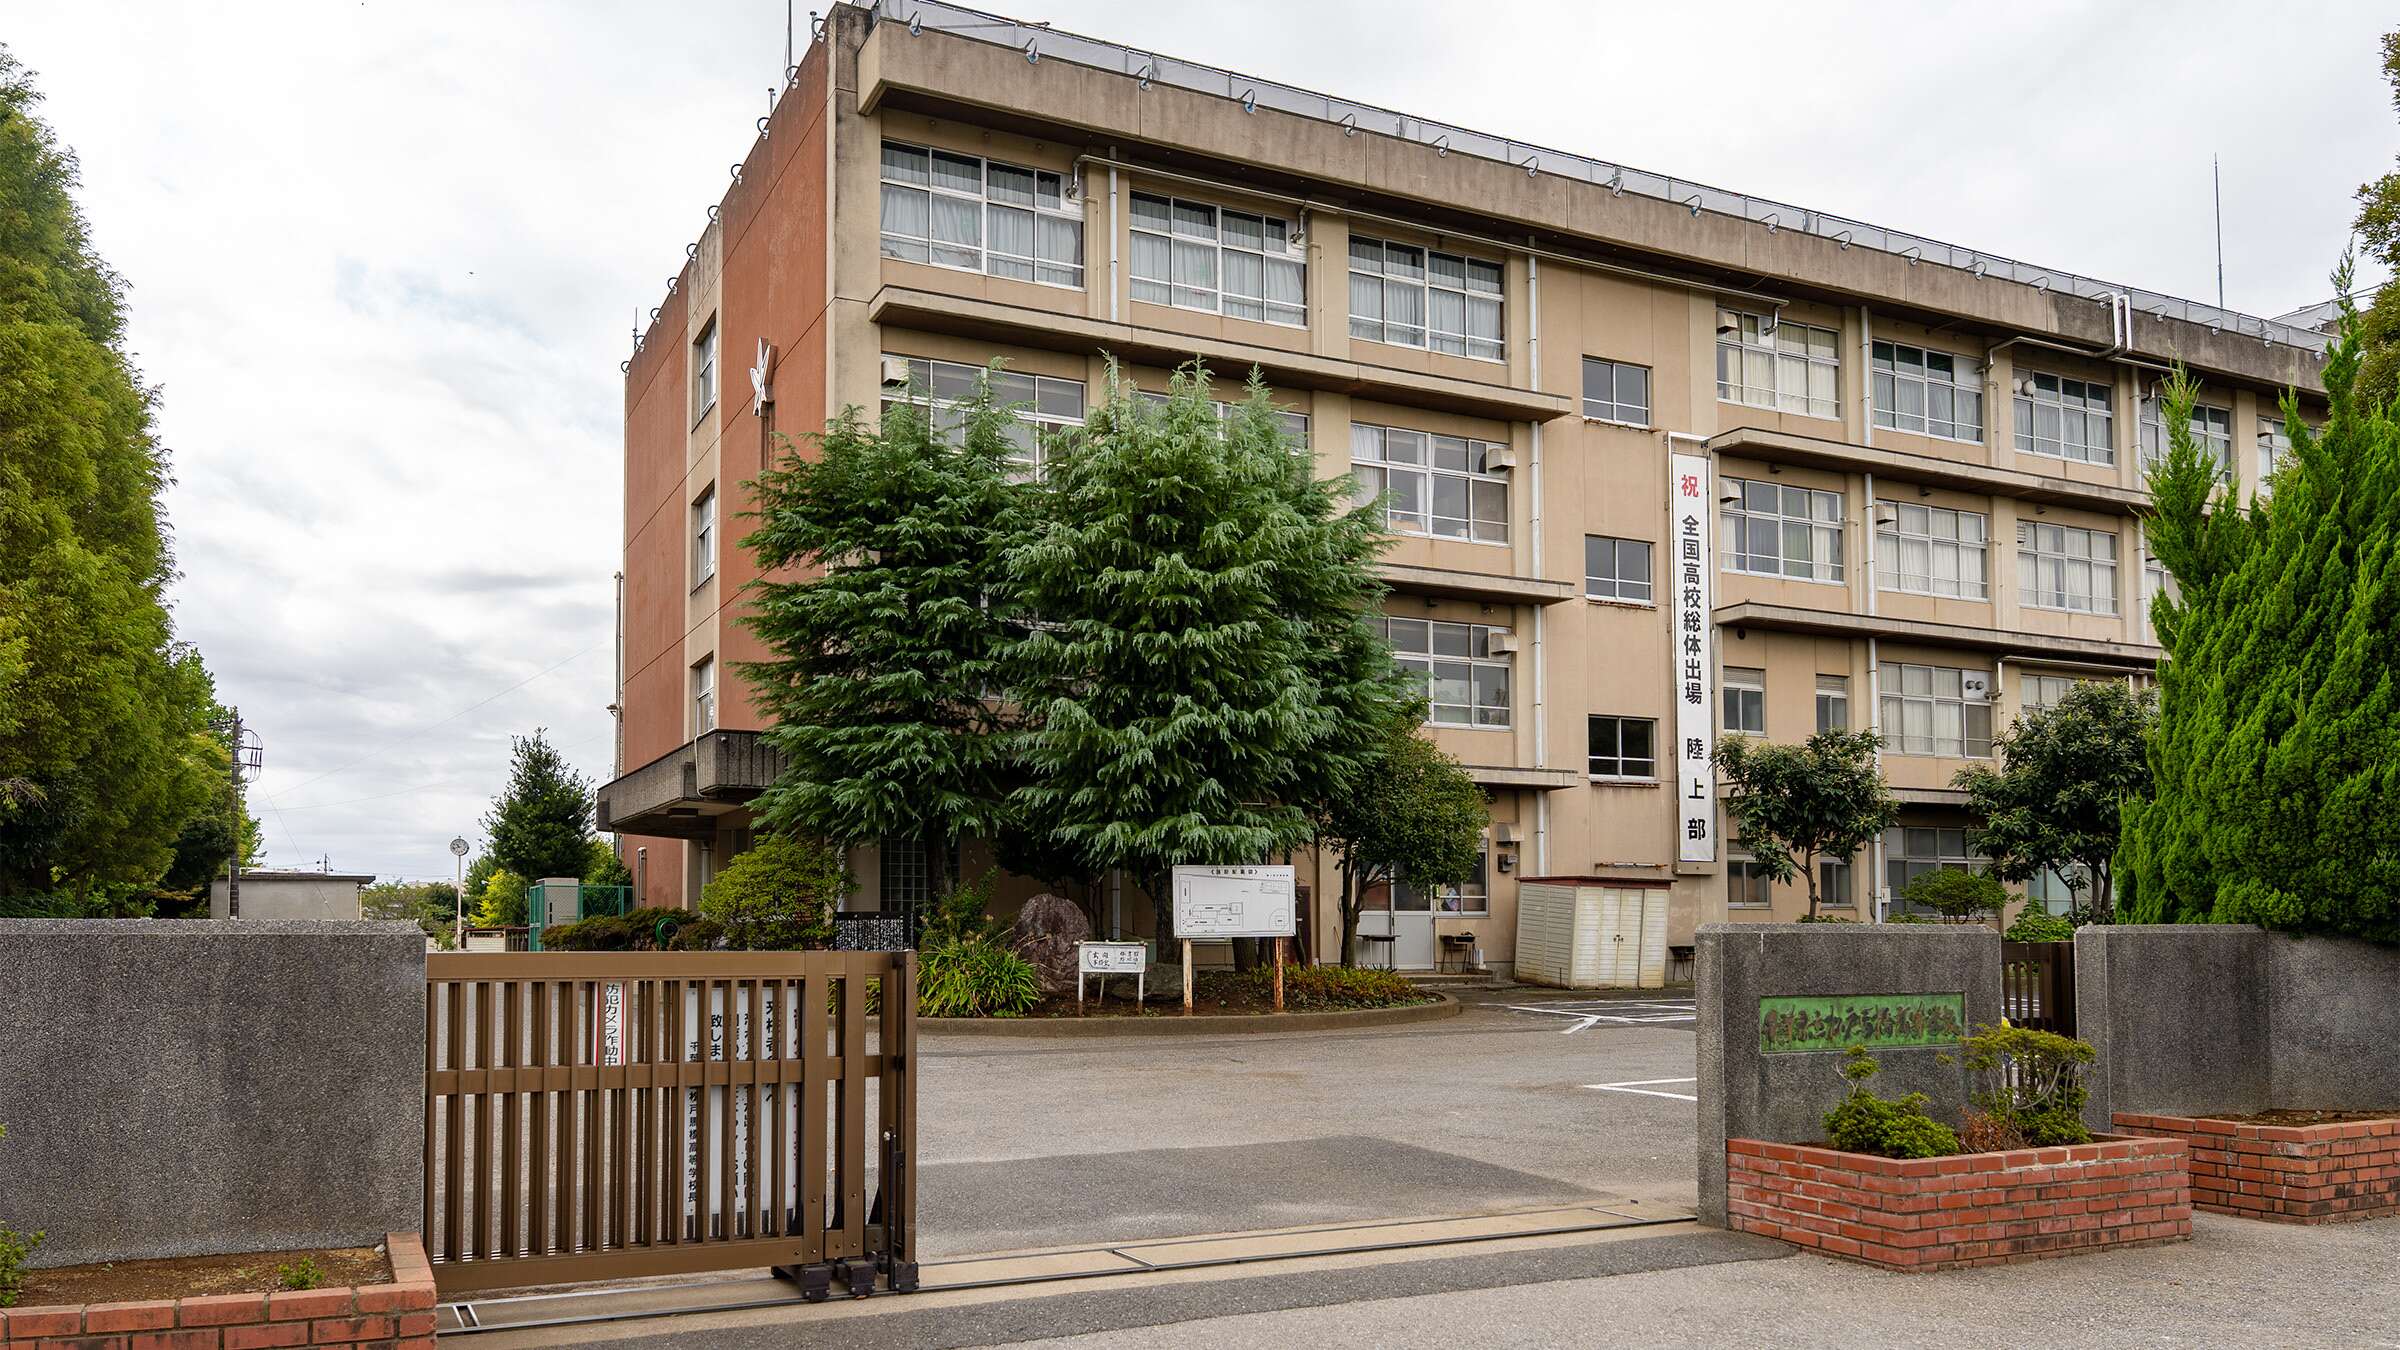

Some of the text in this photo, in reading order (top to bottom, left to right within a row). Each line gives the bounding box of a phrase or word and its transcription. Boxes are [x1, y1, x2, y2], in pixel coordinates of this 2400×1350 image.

[1681, 474, 1707, 841] 祝 全国高校総体出場 陸上部
[711, 1014, 722, 1061] 致しま
